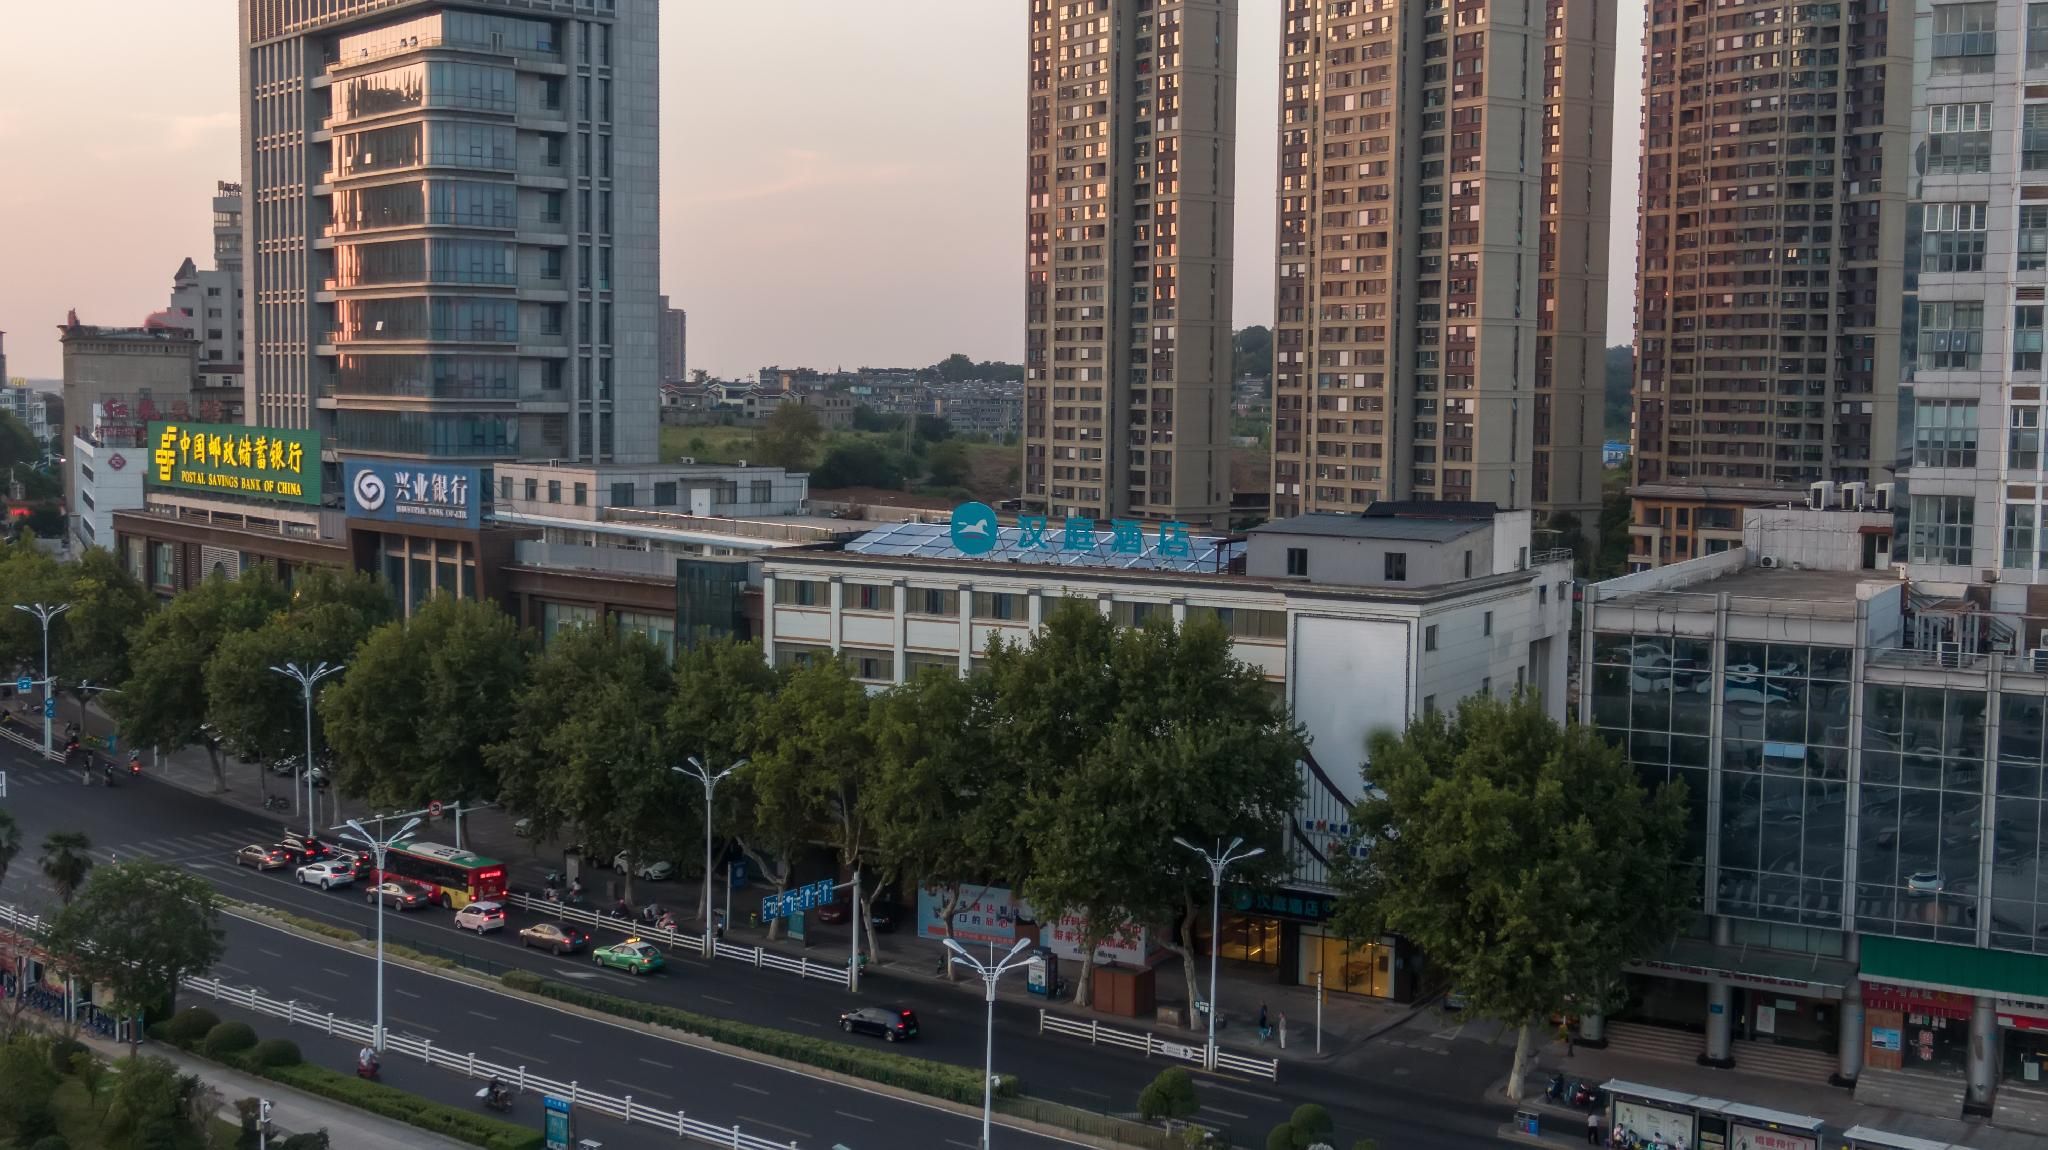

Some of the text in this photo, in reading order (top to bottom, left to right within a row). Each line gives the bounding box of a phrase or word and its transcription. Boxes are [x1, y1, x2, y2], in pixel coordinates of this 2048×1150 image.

[179, 429, 303, 474] 中国邮政储蓄银行
[181, 470, 302, 496] POSTAL SAVINGS BANK OF CHINA
[394, 471, 468, 505] 兴业银行
[1018, 513, 1190, 557] 汉庭酒店
